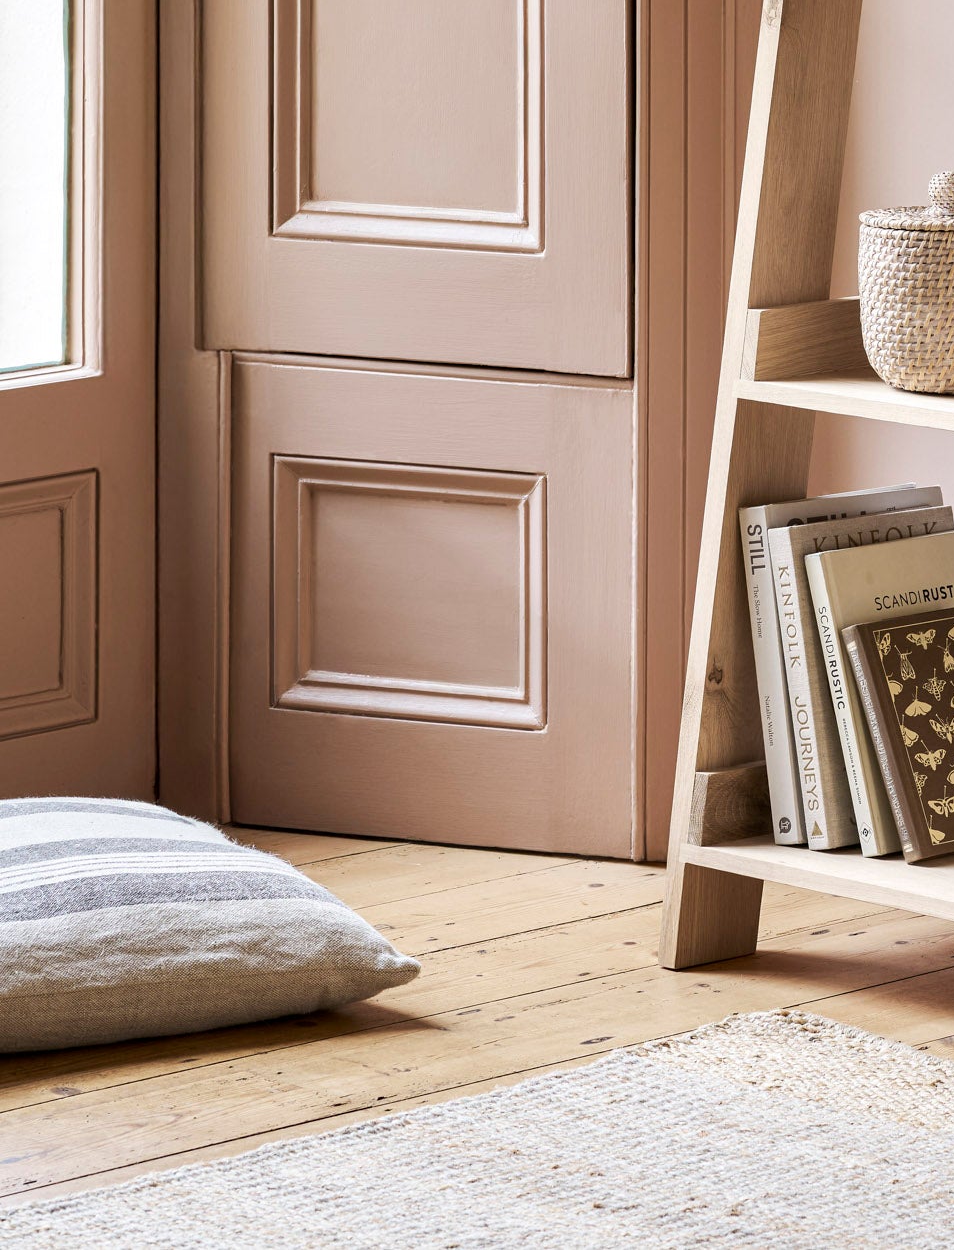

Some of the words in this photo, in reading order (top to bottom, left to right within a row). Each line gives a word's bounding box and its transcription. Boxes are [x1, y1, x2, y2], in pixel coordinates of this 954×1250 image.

[747, 524, 765, 575] STILL
[778, 565, 802, 669] KINFOLK
[794, 696, 819, 811] JOURNEYS
